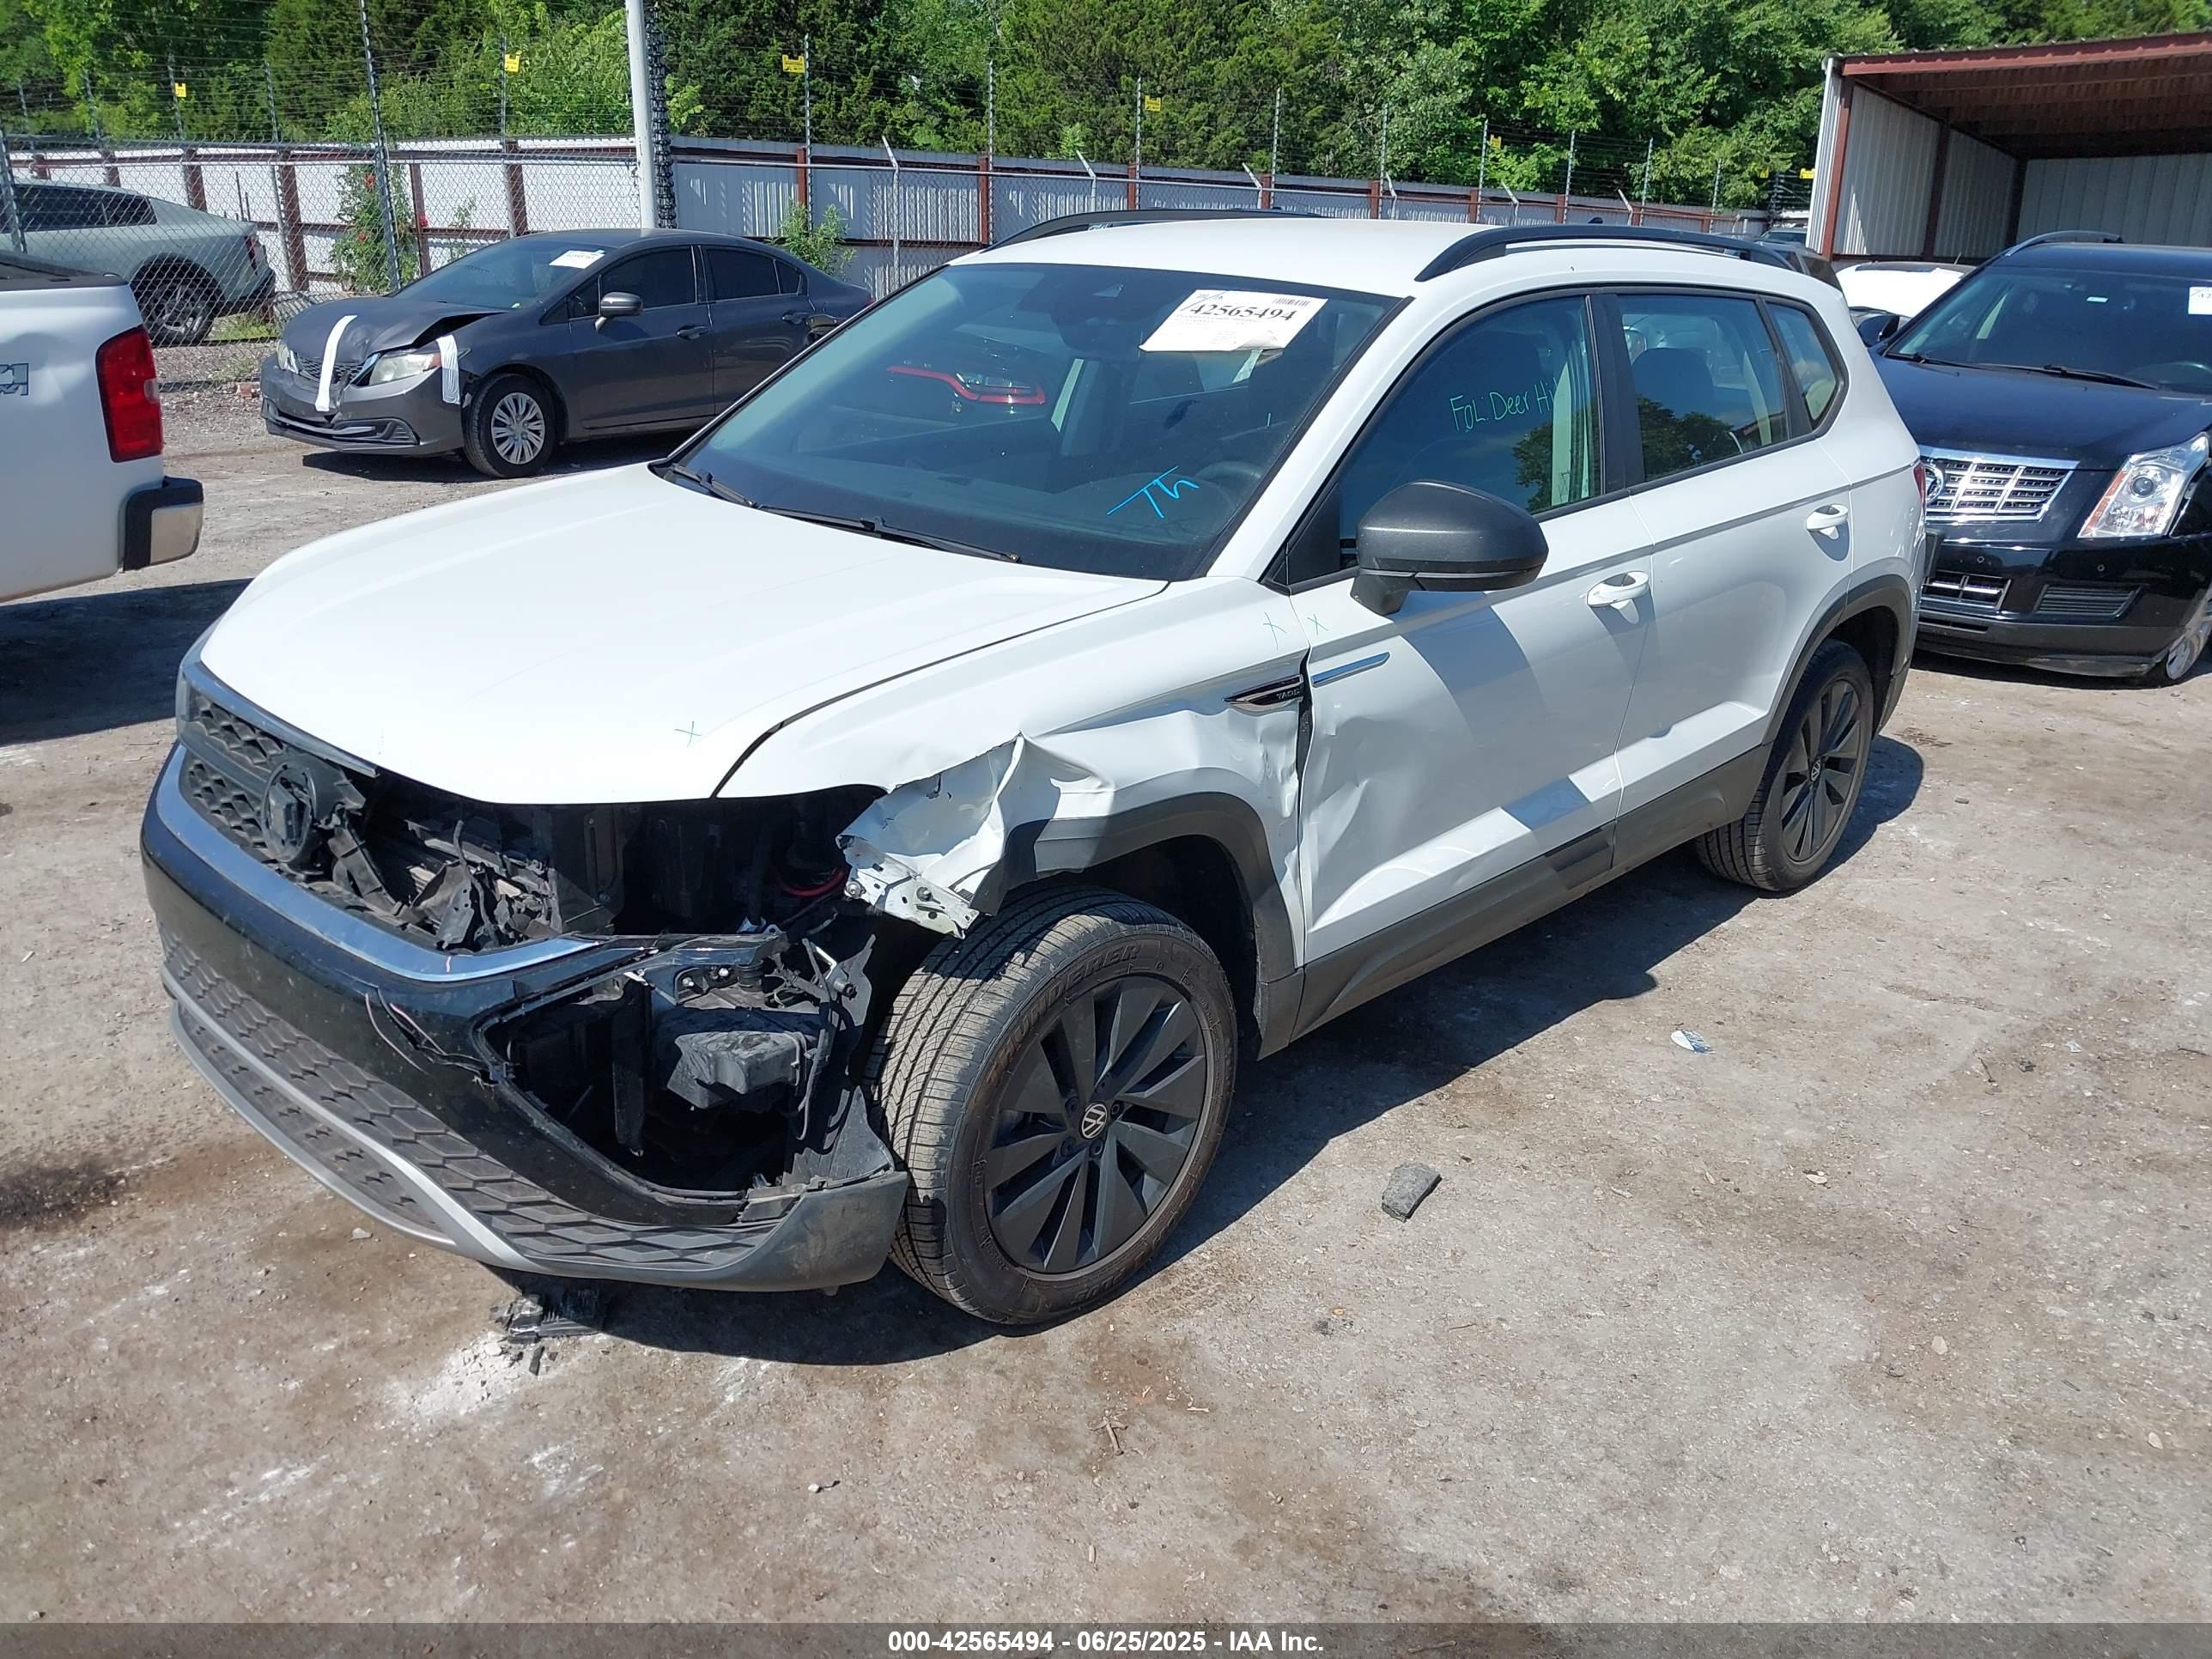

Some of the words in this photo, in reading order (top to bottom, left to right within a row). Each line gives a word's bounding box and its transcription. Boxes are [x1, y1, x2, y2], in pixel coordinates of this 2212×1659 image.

[1190, 303, 1298, 322] 42565494
[1490, 392, 1529, 421] Deer
[985, 945, 1141, 1088] THUNDERER
